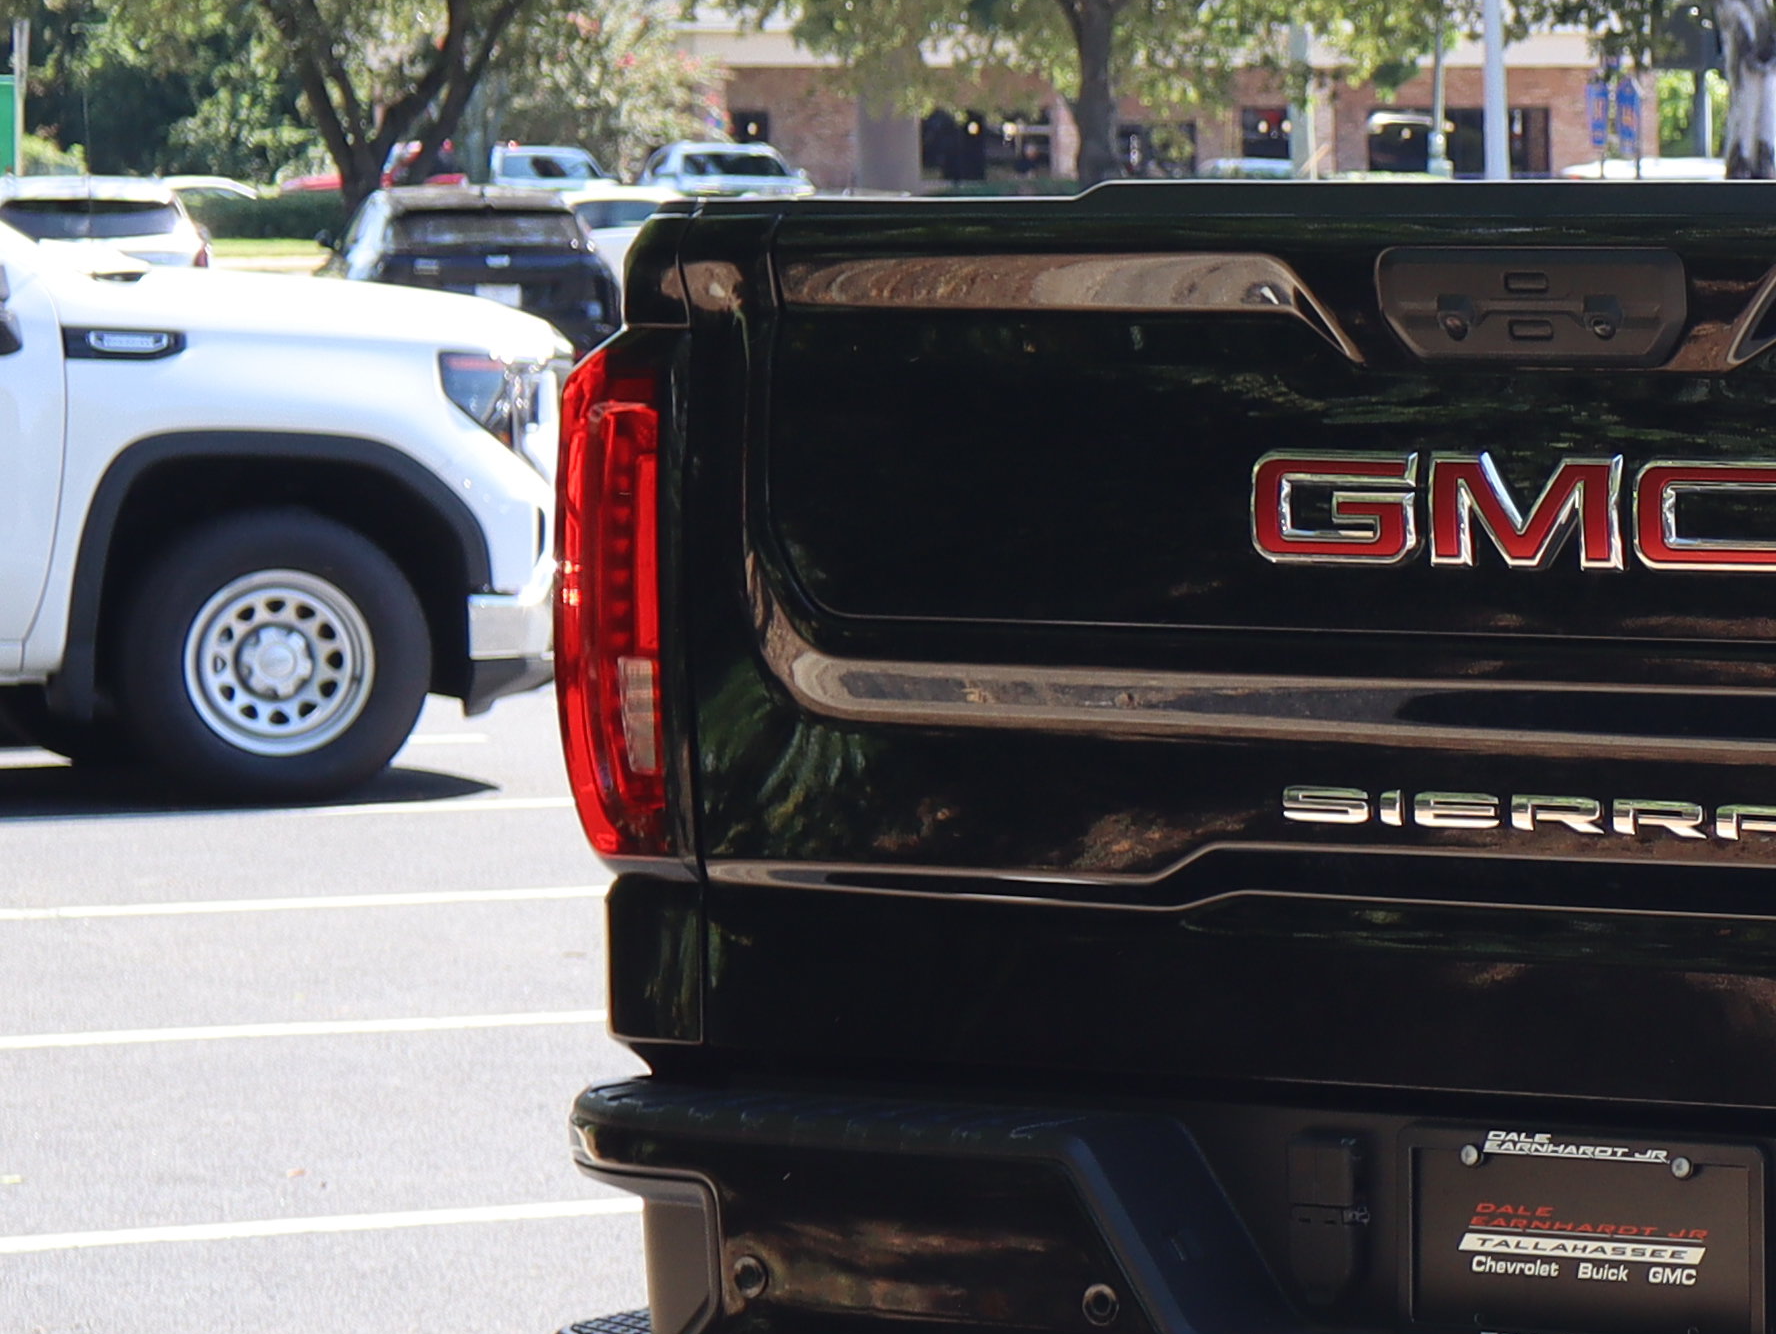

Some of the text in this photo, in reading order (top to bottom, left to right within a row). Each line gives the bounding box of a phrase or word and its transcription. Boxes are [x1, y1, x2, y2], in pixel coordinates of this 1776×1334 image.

[1487, 1130, 1551, 1143] DALE
[1484, 1142, 1628, 1159] EARNHARDT
[1475, 1203, 1554, 1217] DALE
[1470, 1216, 1709, 1240] EARNHARDT JR
[1476, 1237, 1688, 1260] TALLAHASSEE
[1472, 1255, 1697, 1286] Chevrolet Buick GMC
